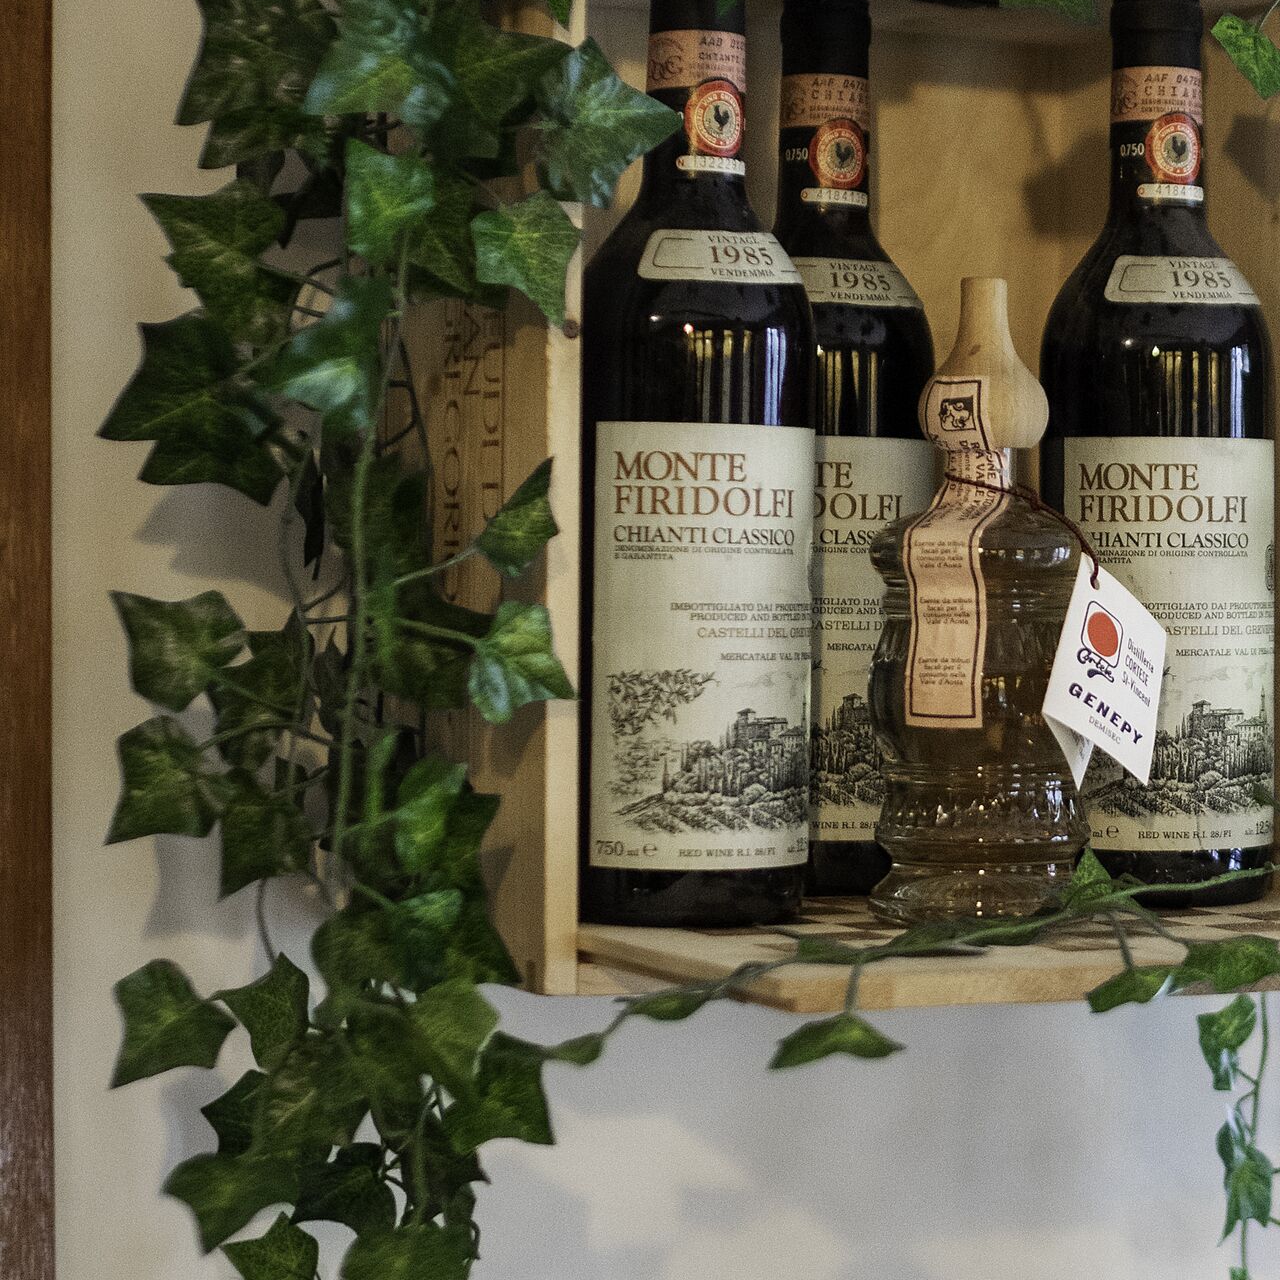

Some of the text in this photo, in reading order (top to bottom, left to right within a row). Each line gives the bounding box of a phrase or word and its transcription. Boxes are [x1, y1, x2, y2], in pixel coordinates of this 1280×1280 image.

[708, 234, 760, 245] VINTAGE
[709, 245, 774, 266] 1985
[829, 262, 880, 273] VINTAGE
[1169, 260, 1217, 269] VINTAGE
[710, 267, 775, 278] VENDEMMIA
[829, 271, 891, 291] 1985
[1171, 270, 1232, 289] 1985
[830, 291, 892, 302] VENDEMMIA
[1172, 291, 1233, 299] VENDEMMIA
[614, 450, 747, 482] MONTE
[1078, 463, 1200, 491] MONTE
[614, 485, 795, 518] FIRIDOLFI
[1078, 494, 1248, 524] FIRIDOLFI
[614, 525, 795, 546] CHIANTI CLASSICO
[1086, 531, 1249, 549] HIANTI CLASSICO
[614, 545, 690, 553] DENOMINAZIONE
[704, 546, 741, 554] ORIGINE
[1147, 550, 1158, 558] DI
[1160, 550, 1196, 558] ORIGINE
[1197, 550, 1249, 558] CONTROLLATA
[670, 602, 755, 611] IMBOTTIGLIATO
[756, 603, 773, 612] DAI
[856, 607, 876, 615] AND
[1210, 602, 1228, 611] DAI
[690, 612, 748, 621] PRODUCED
[750, 612, 770, 621] AND
[1204, 612, 1224, 620] AND
[697, 627, 765, 639] CASTELLI
[767, 627, 787, 639] DEL
[1221, 625, 1243, 636] DEL
[720, 652, 776, 661] MERCATALE
[1175, 648, 1231, 657] MERCATALE
[1234, 648, 1249, 657] VAL
[1125, 654, 1149, 686] CORTESE
[1068, 682, 1144, 745] GENEPY
[1088, 715, 1122, 745] DEMISEC
[812, 821, 839, 829] WINE
[1138, 830, 1160, 839] RED
[1162, 831, 1190, 839] WINE
[596, 839, 624, 856] 750
[679, 848, 702, 857] RED
[706, 848, 734, 857] WINE
